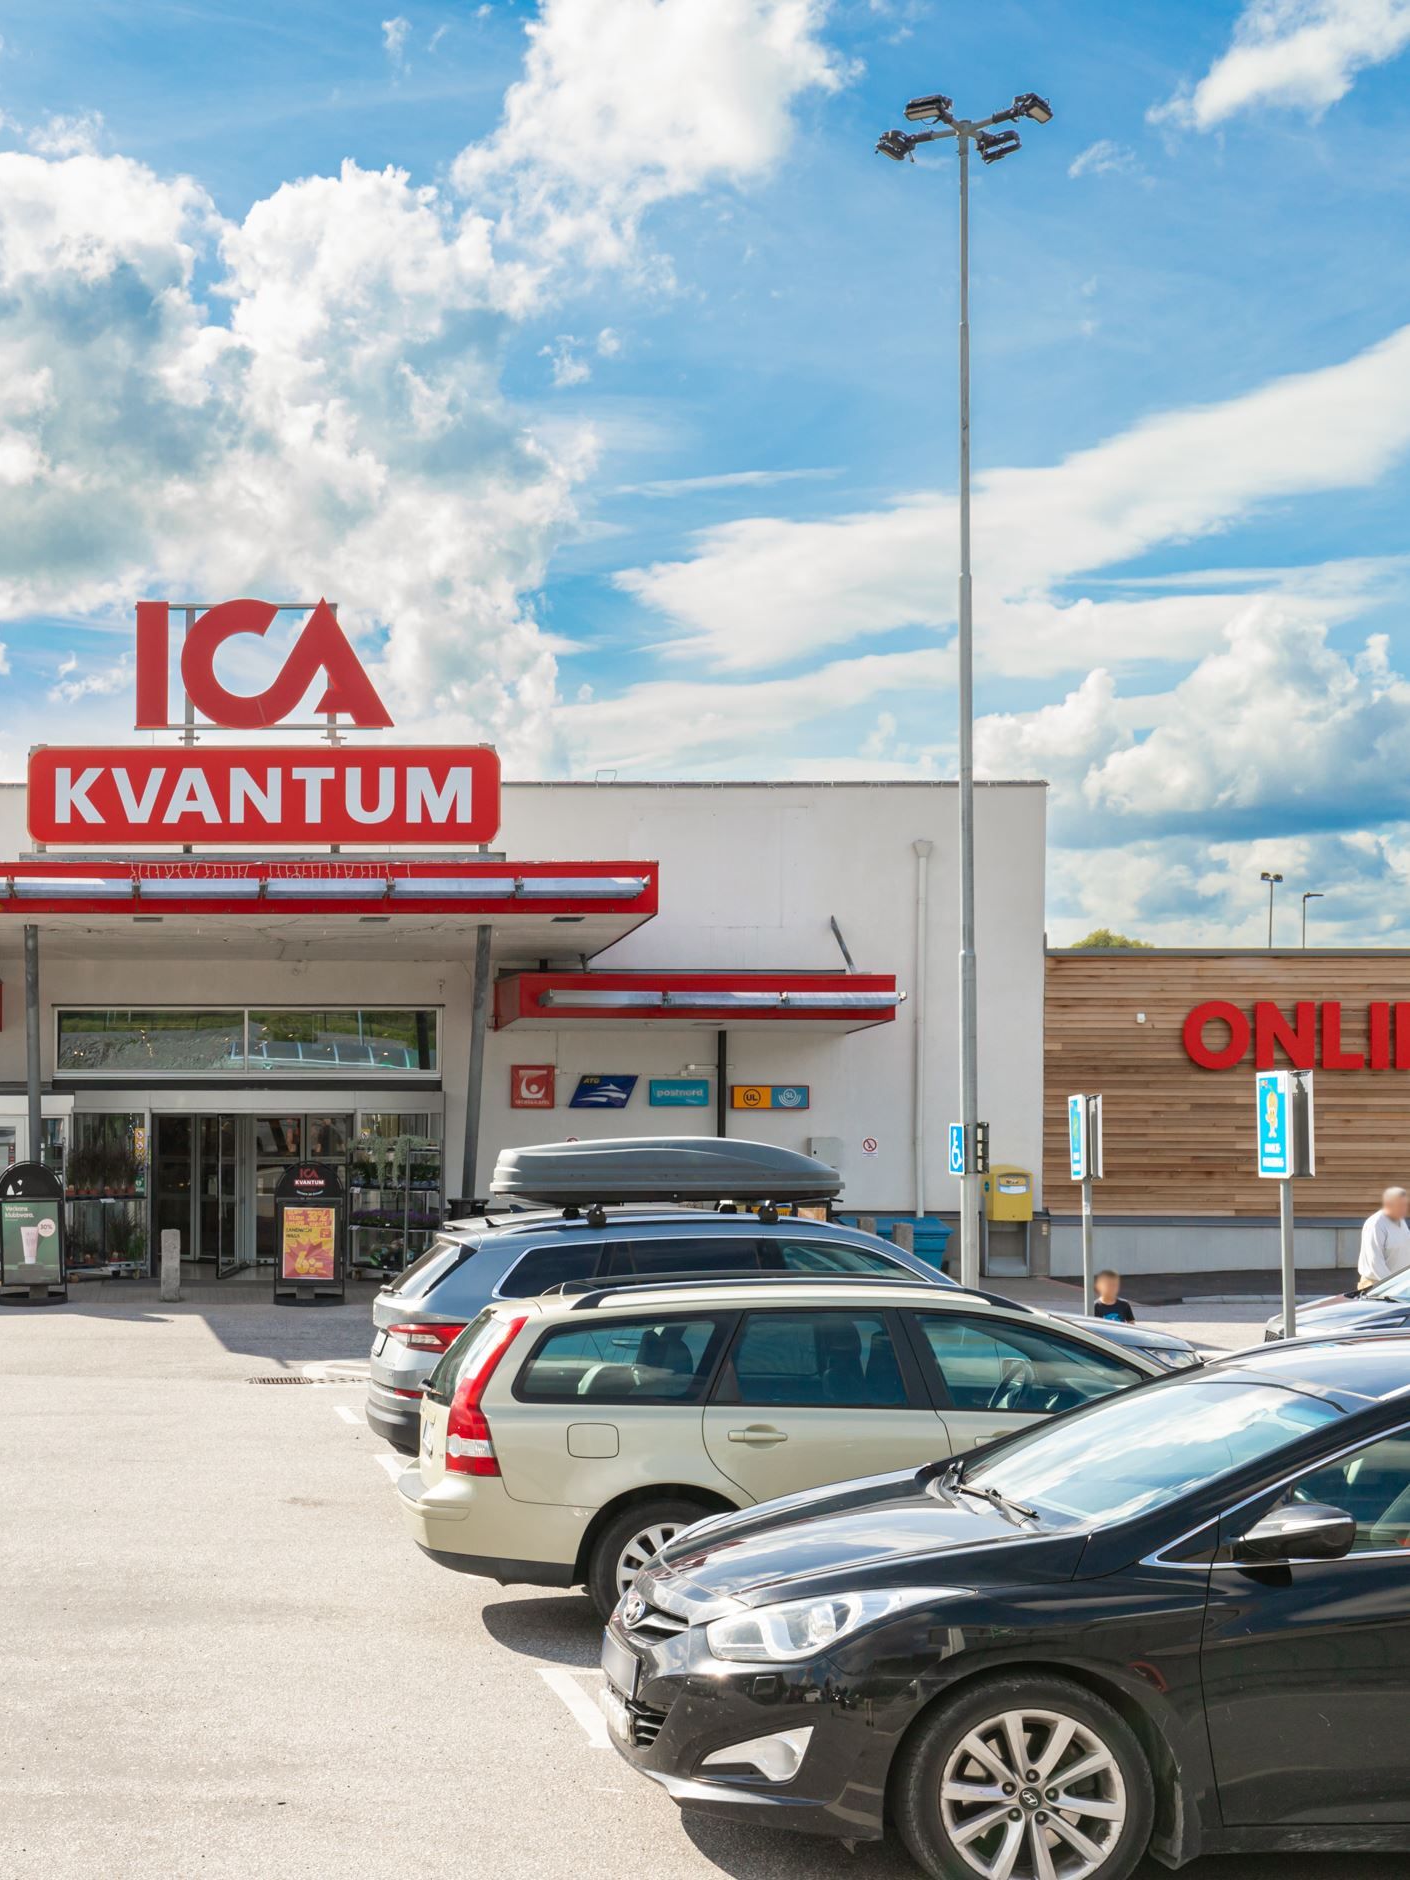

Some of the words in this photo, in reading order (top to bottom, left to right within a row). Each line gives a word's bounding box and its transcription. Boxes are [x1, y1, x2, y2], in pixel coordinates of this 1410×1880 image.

[136, 596, 395, 730] ICA
[54, 766, 473, 824] KVANTUM
[1182, 1000, 1410, 1070] ONLI
[656, 1088, 703, 1098] postnord
[300, 1168, 318, 1178] ICA
